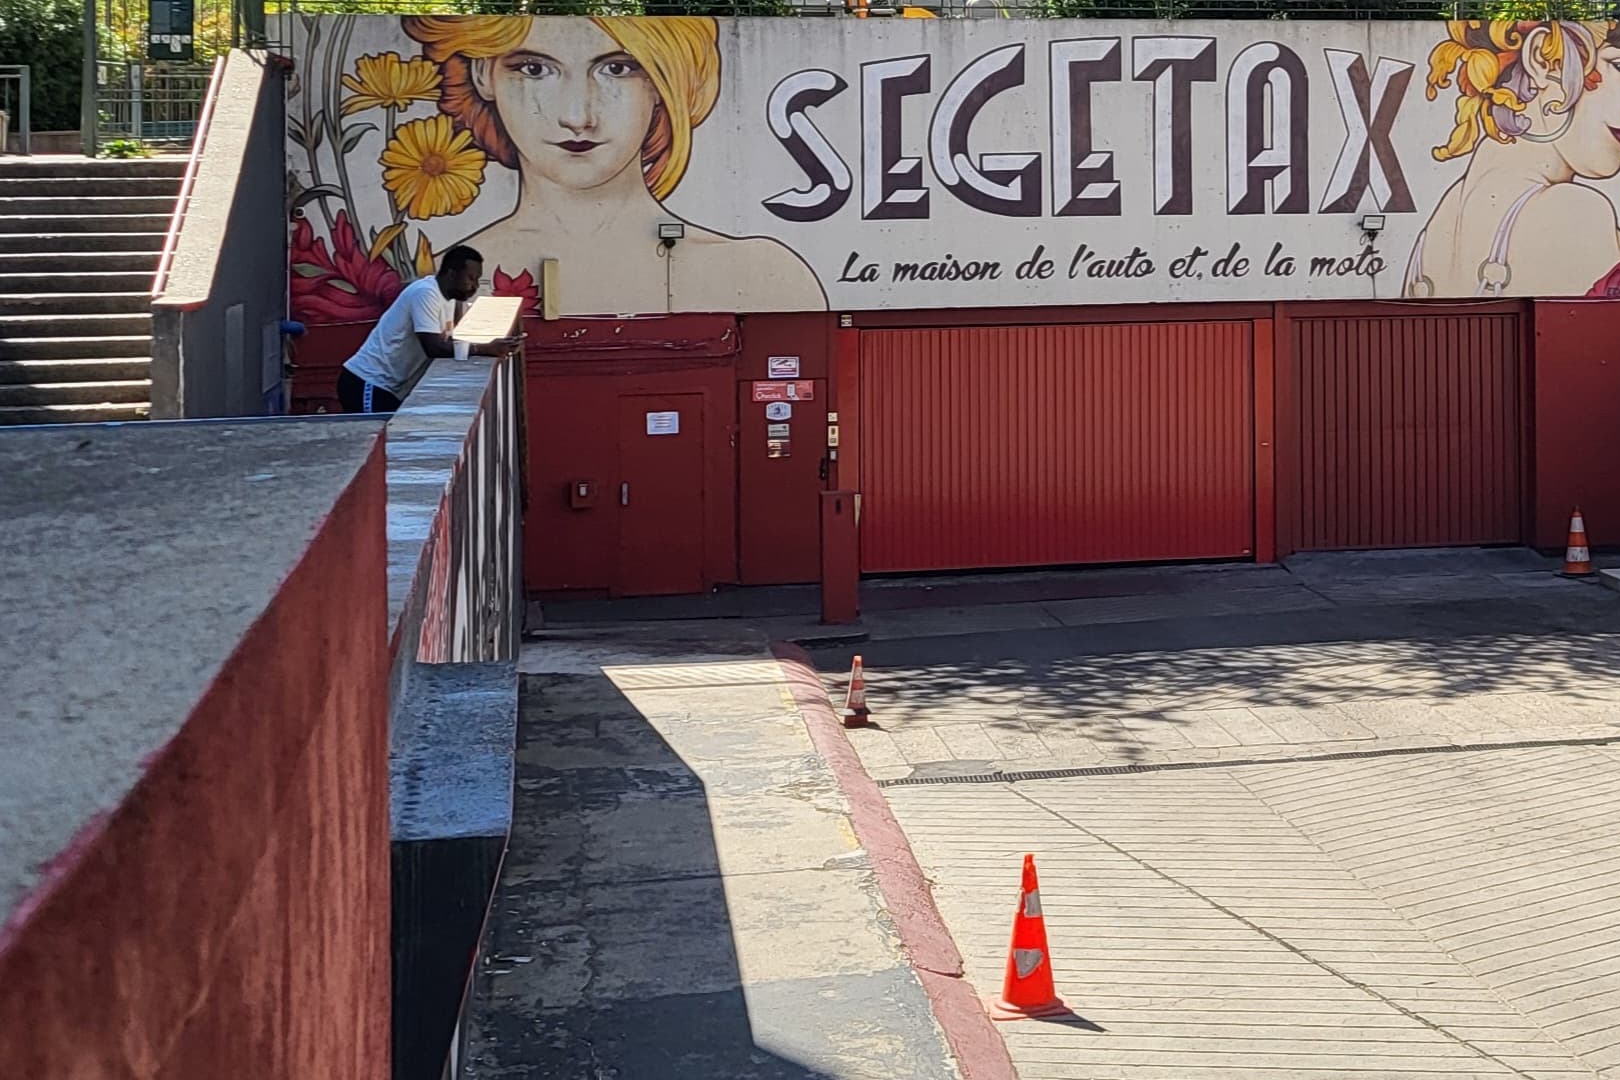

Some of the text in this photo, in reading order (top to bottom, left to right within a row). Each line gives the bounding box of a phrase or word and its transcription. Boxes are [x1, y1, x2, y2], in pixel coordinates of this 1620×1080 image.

[761, 35, 1418, 222] SEGETAX
[836, 251, 880, 283] La
[892, 253, 1002, 283] maison
[1016, 244, 1055, 280] de
[1068, 244, 1156, 279] l'auto
[1212, 242, 1250, 278] de
[1264, 242, 1296, 277] la
[1309, 244, 1388, 278] moto
